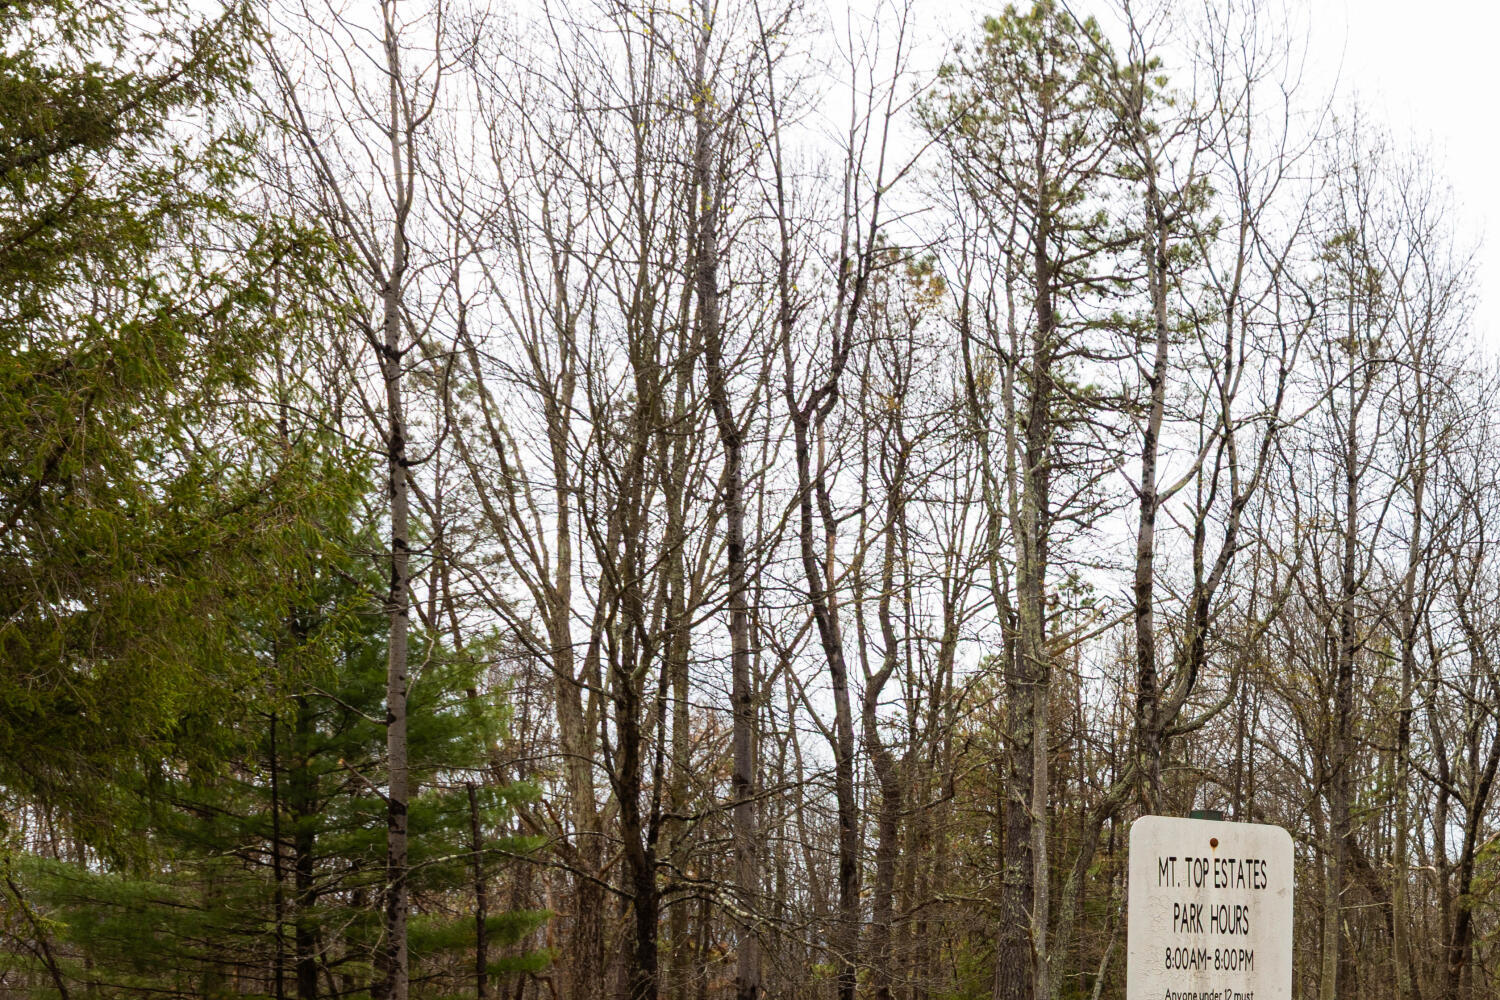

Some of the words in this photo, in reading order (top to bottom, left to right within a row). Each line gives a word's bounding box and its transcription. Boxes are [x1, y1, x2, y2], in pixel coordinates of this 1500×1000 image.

[1159, 857, 1180, 888] MT.
[1185, 857, 1209, 888] TOP
[1214, 858, 1267, 890] ESTATES
[1173, 902, 1204, 934] PARK
[1210, 904, 1249, 936] HOURS
